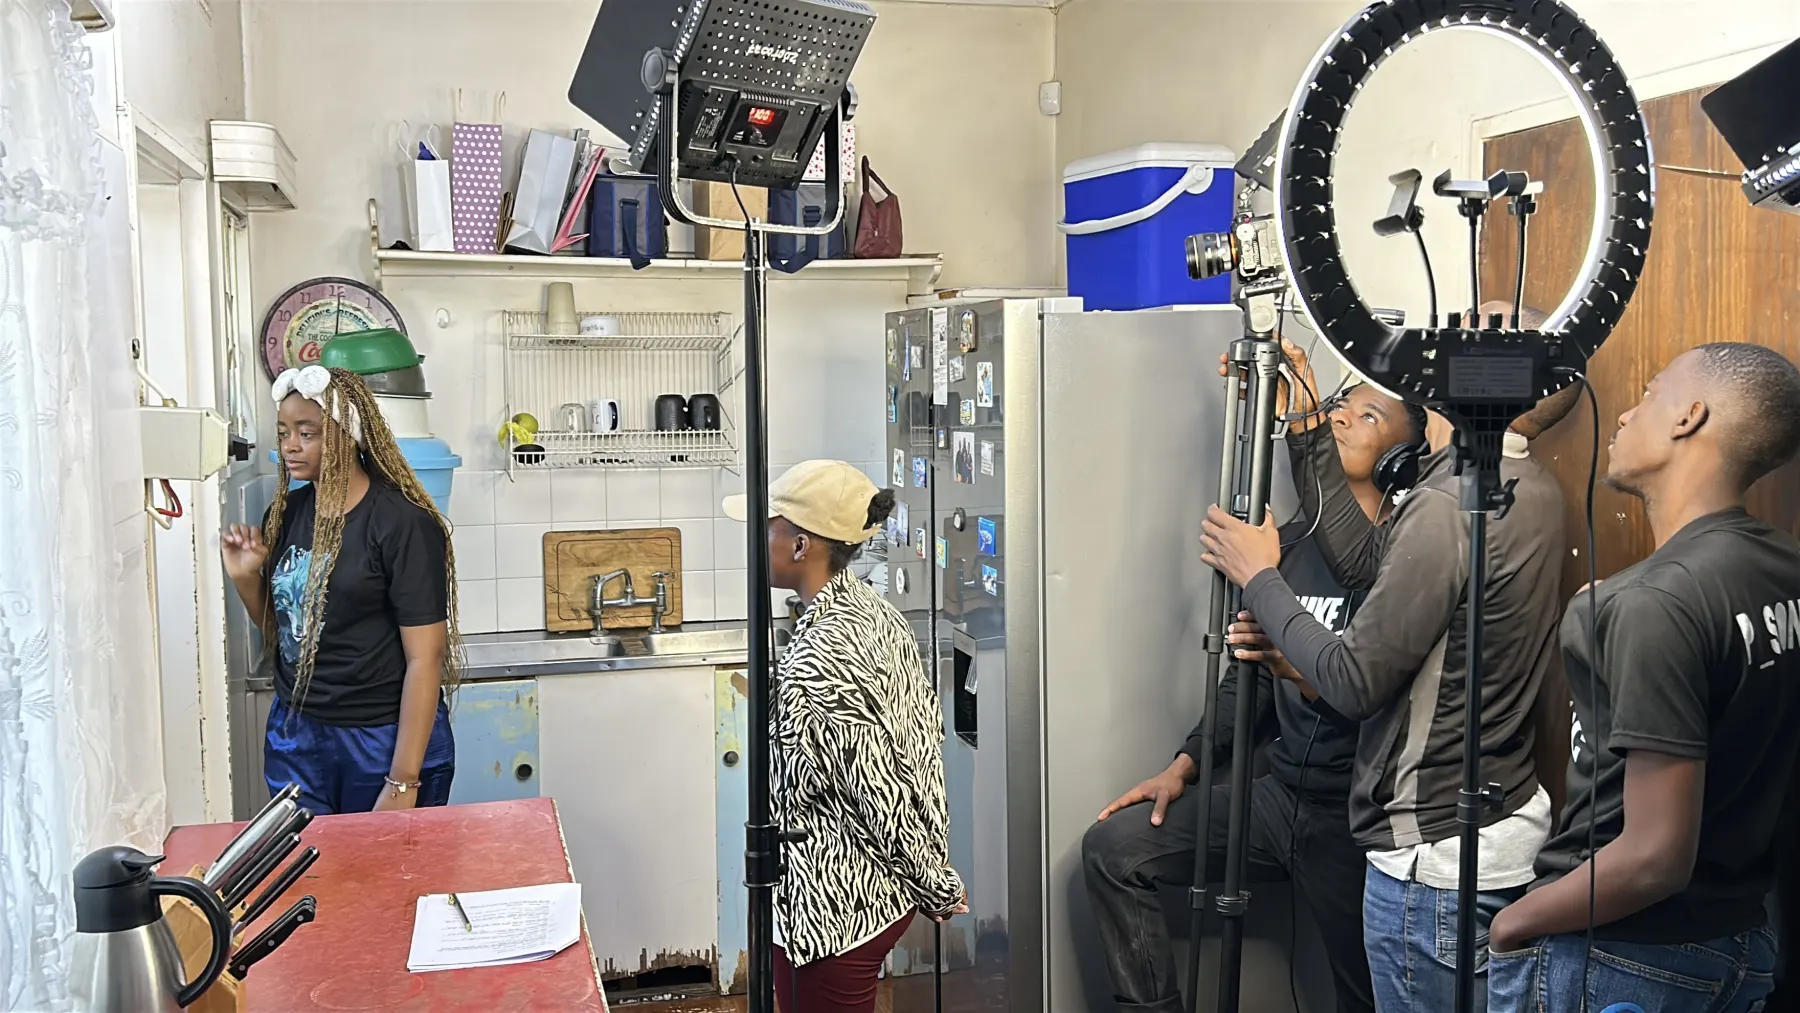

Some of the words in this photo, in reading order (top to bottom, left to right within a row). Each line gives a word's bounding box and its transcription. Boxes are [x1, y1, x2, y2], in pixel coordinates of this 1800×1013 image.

[328, 285, 346, 298] 12
[300, 293, 312, 304] 11
[365, 297, 373, 309] 1
[278, 310, 292, 322] 10
[268, 337, 277, 349] 9
[308, 333, 319, 341] THE
